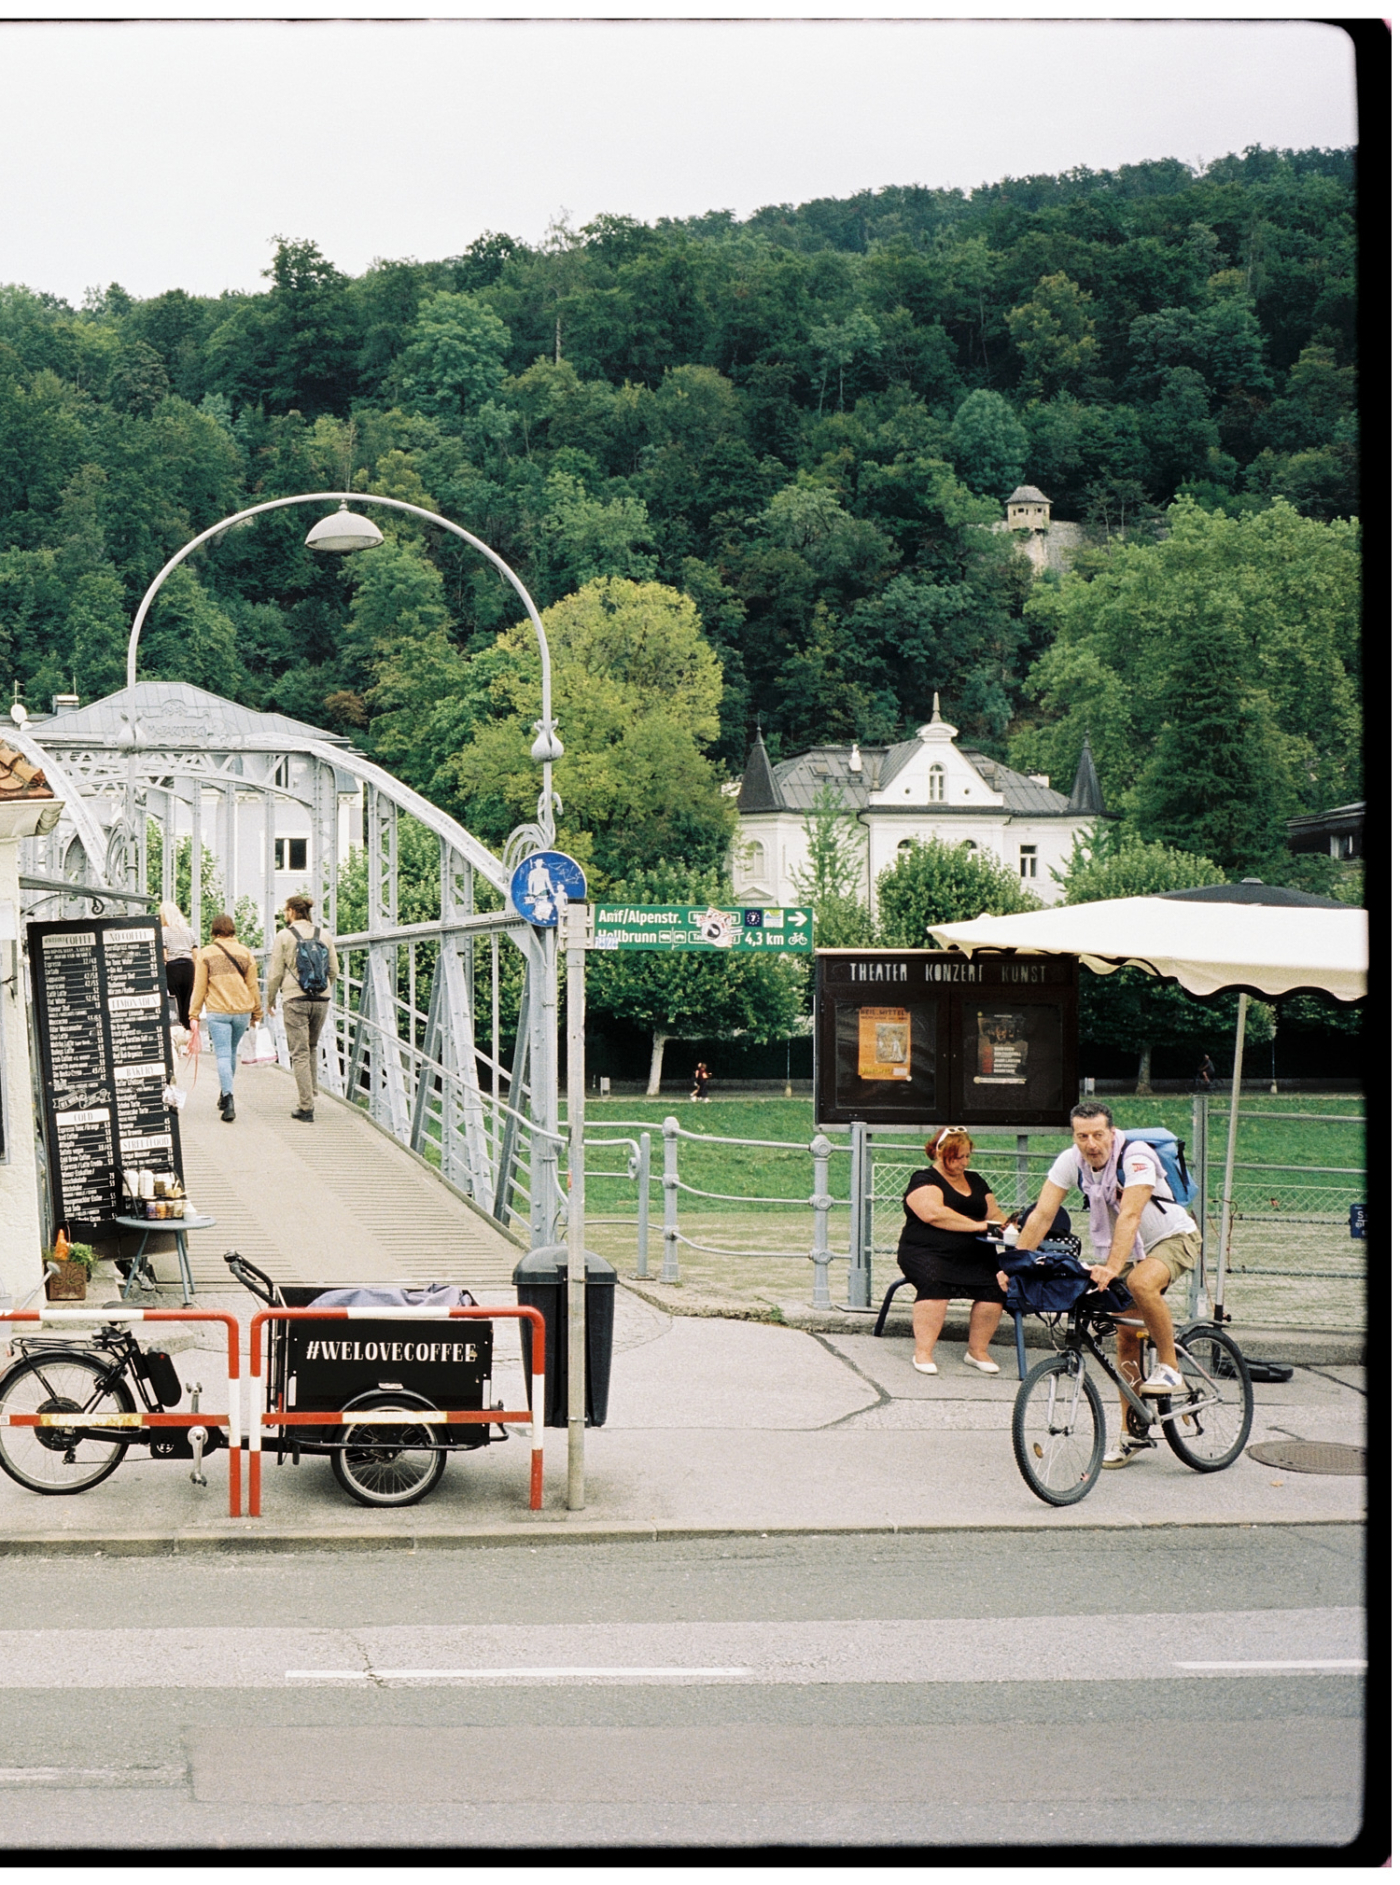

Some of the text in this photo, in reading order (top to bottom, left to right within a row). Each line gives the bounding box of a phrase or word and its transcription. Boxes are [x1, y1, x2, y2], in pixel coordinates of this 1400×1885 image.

[599, 908, 682, 926] Anif/Alpenstr.
[745, 932, 763, 947] 4,3
[766, 932, 784, 945] km
[850, 963, 1046, 983] THEATER KONZERT KUNST
[306, 1340, 477, 1363] #WELOVECOFFEE
